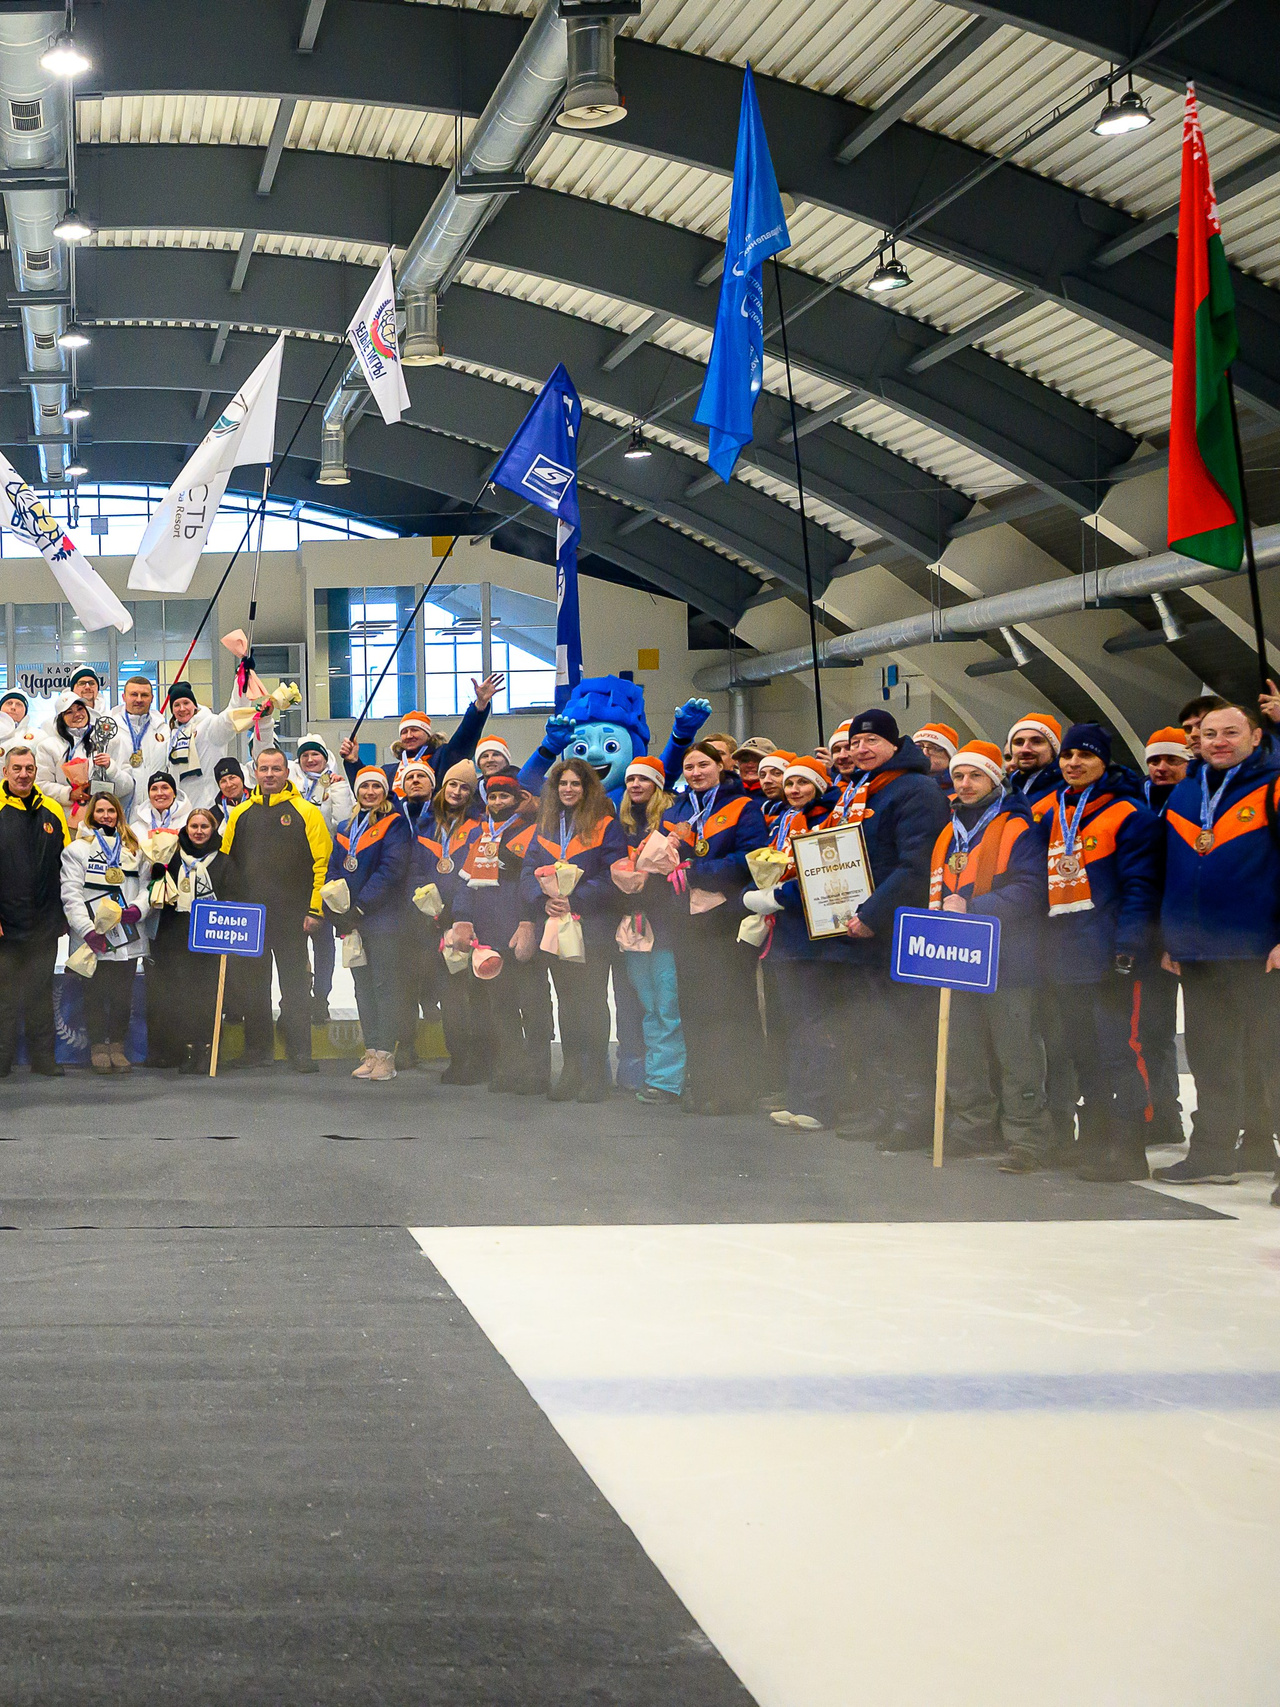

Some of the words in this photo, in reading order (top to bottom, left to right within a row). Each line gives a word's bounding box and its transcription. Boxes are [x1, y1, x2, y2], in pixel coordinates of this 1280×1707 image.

[173, 506, 184, 538] Resort
[47, 666, 78, 674] КАФ
[803, 859, 861, 877] СЕРТИФИКАТ
[208, 910, 248, 927] Белые
[205, 928, 249, 945] тигры
[908, 936, 982, 965] Молния
